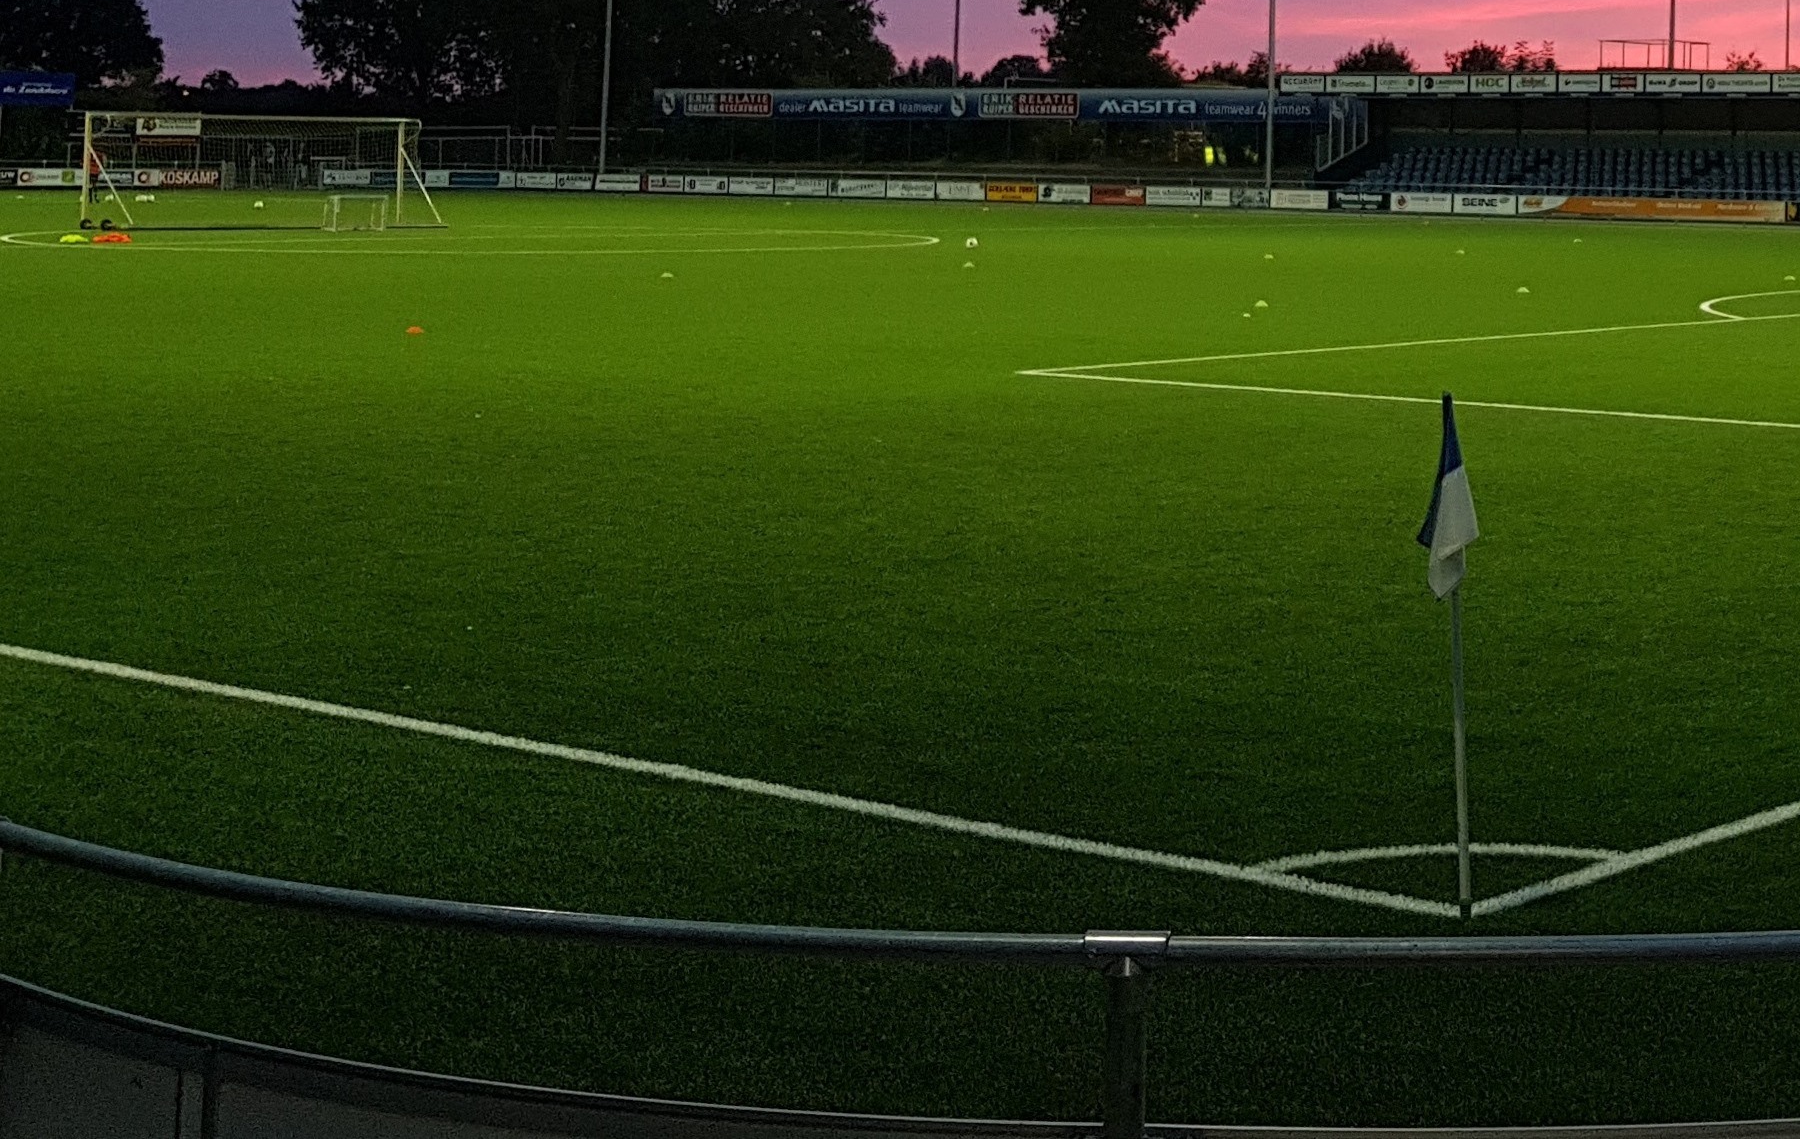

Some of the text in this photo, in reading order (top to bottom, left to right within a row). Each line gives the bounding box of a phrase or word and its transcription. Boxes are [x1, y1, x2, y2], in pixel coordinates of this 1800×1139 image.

[719, 93, 769, 103] RELATIE
[1018, 94, 1075, 103] RELATIE
[779, 102, 806, 113] dealer
[899, 102, 943, 115] teamwear
[1018, 104, 1075, 114] GESCHENKEN
[1205, 102, 1255, 116] teamwear
[1257, 102, 1268, 118] 4
[159, 170, 219, 185] KOSKAMP
